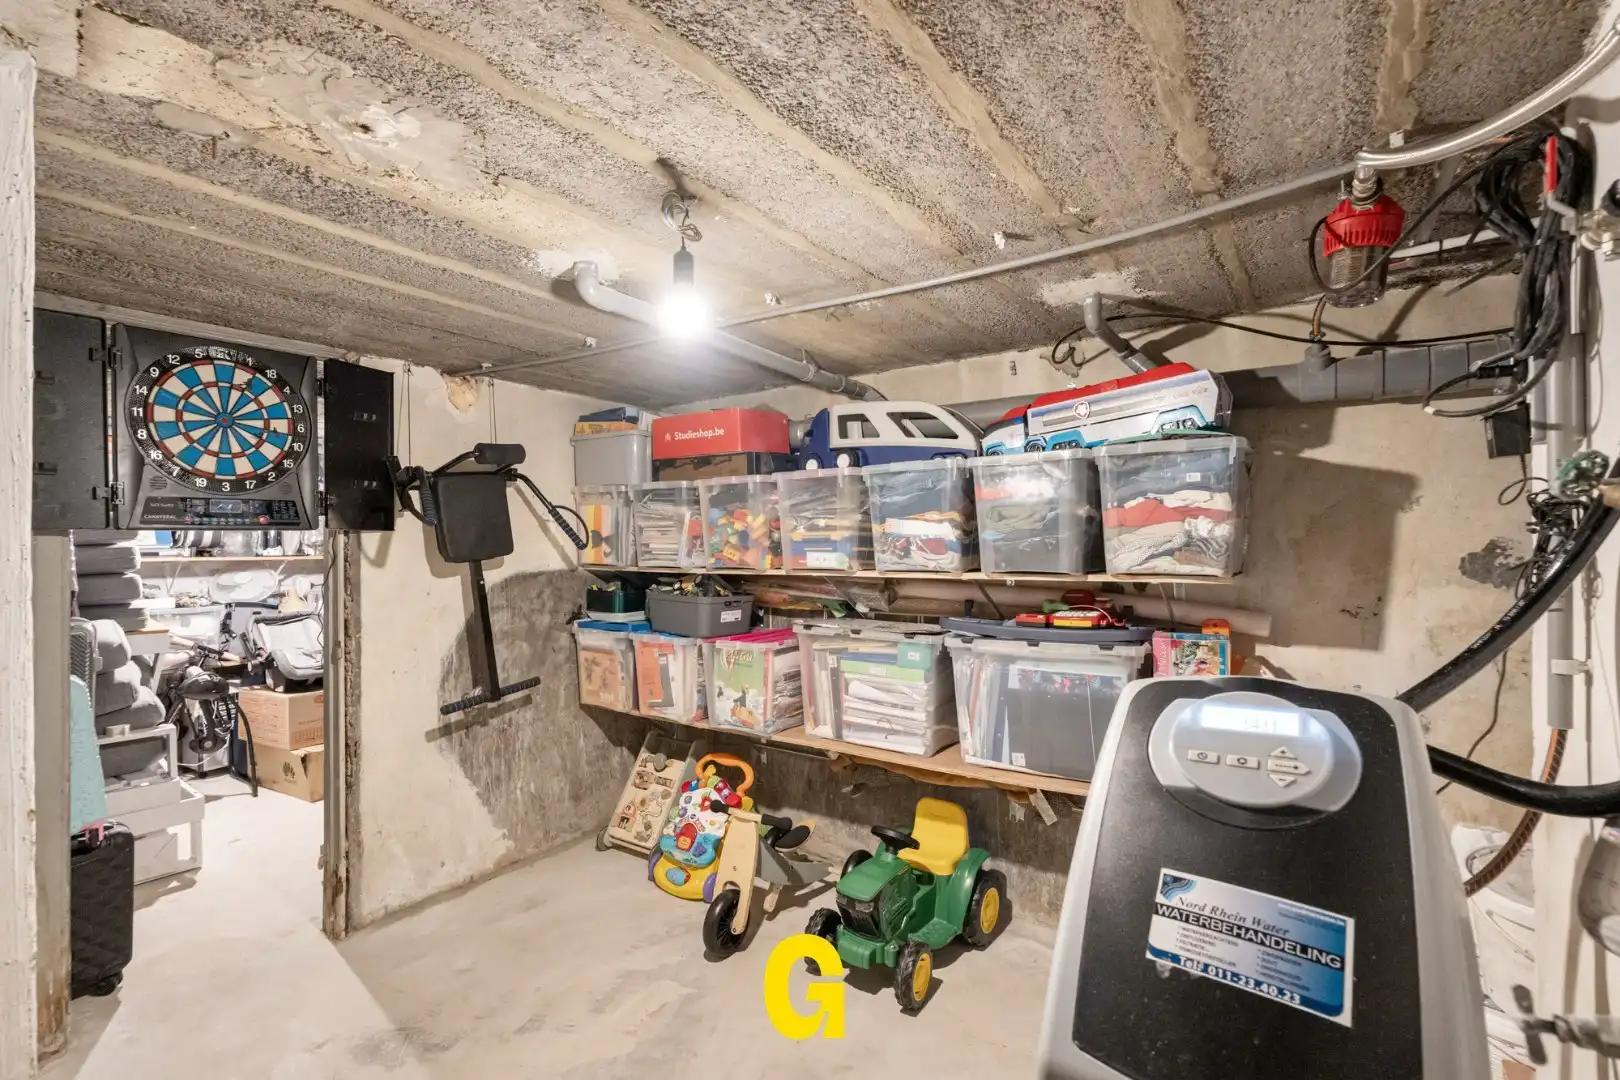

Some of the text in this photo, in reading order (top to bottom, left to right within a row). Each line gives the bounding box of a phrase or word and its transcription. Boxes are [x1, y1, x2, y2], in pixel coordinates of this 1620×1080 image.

[194, 348, 203, 359] 5
[167, 354, 180, 365] 12
[150, 366, 159, 377] 9
[265, 369, 277, 379] 18
[134, 385, 148, 396] 14
[283, 385, 291, 394] 4
[131, 407, 144, 417] 11
[292, 404, 303, 413] 13
[297, 424, 305, 433] 6
[137, 429, 147, 440] 8
[673, 426, 725, 442] Studieshop.be
[292, 442, 303, 452] 10
[150, 449, 163, 460] 16
[282, 459, 294, 468] 15
[267, 471, 276, 481] 2
[194, 478, 207, 488] 19
[221, 482, 230, 492] 3
[244, 480, 256, 489] 17
[1175, 896, 1207, 913] Nord
[1210, 906, 1248, 925] Rhein
[1251, 916, 1290, 935] Water
[1156, 903, 1343, 969] WATERBEHANDELING
[1206, 965, 1301, 1005] 011-23.40.23
